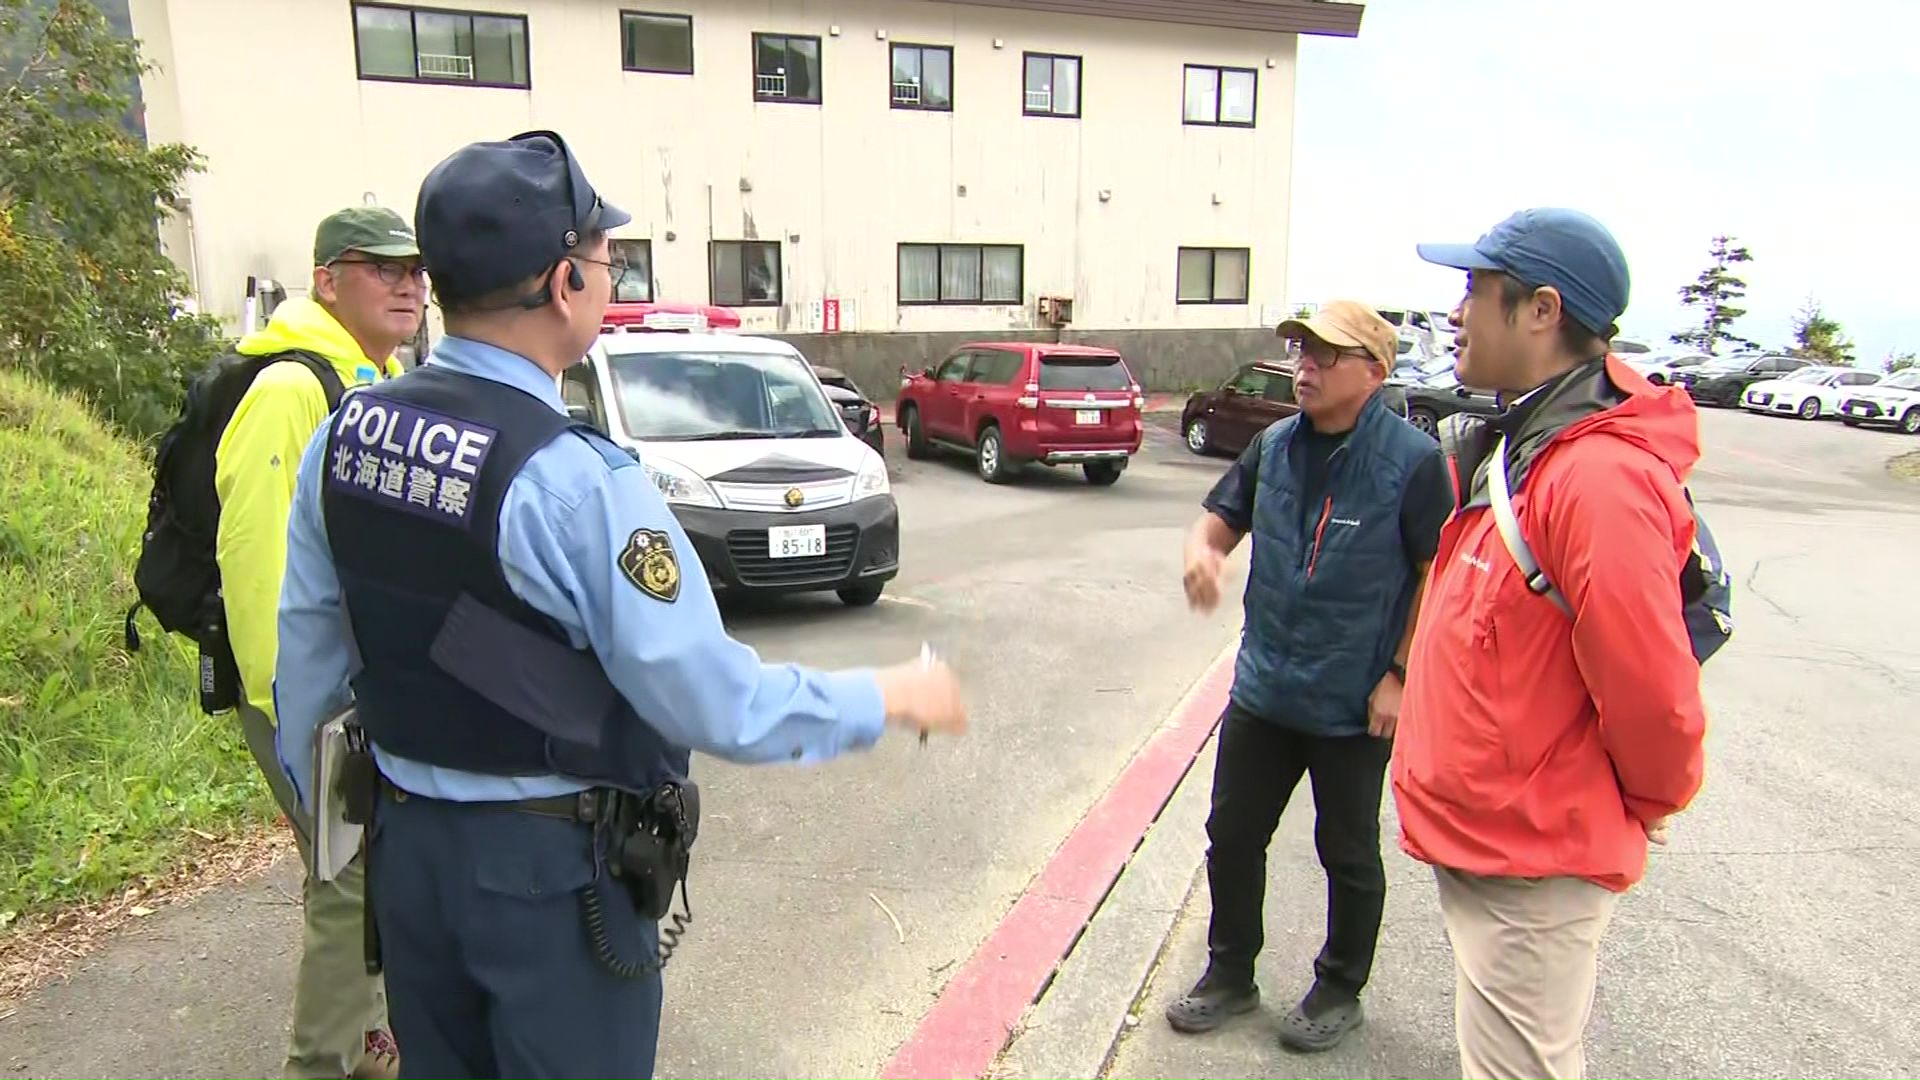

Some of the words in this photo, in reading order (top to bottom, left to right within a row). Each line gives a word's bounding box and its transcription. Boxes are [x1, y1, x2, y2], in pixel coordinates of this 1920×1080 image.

[336, 400, 489, 475] POLICE
[332, 444, 471, 517] 北海道警察
[782, 537, 822, 555] 85-18
